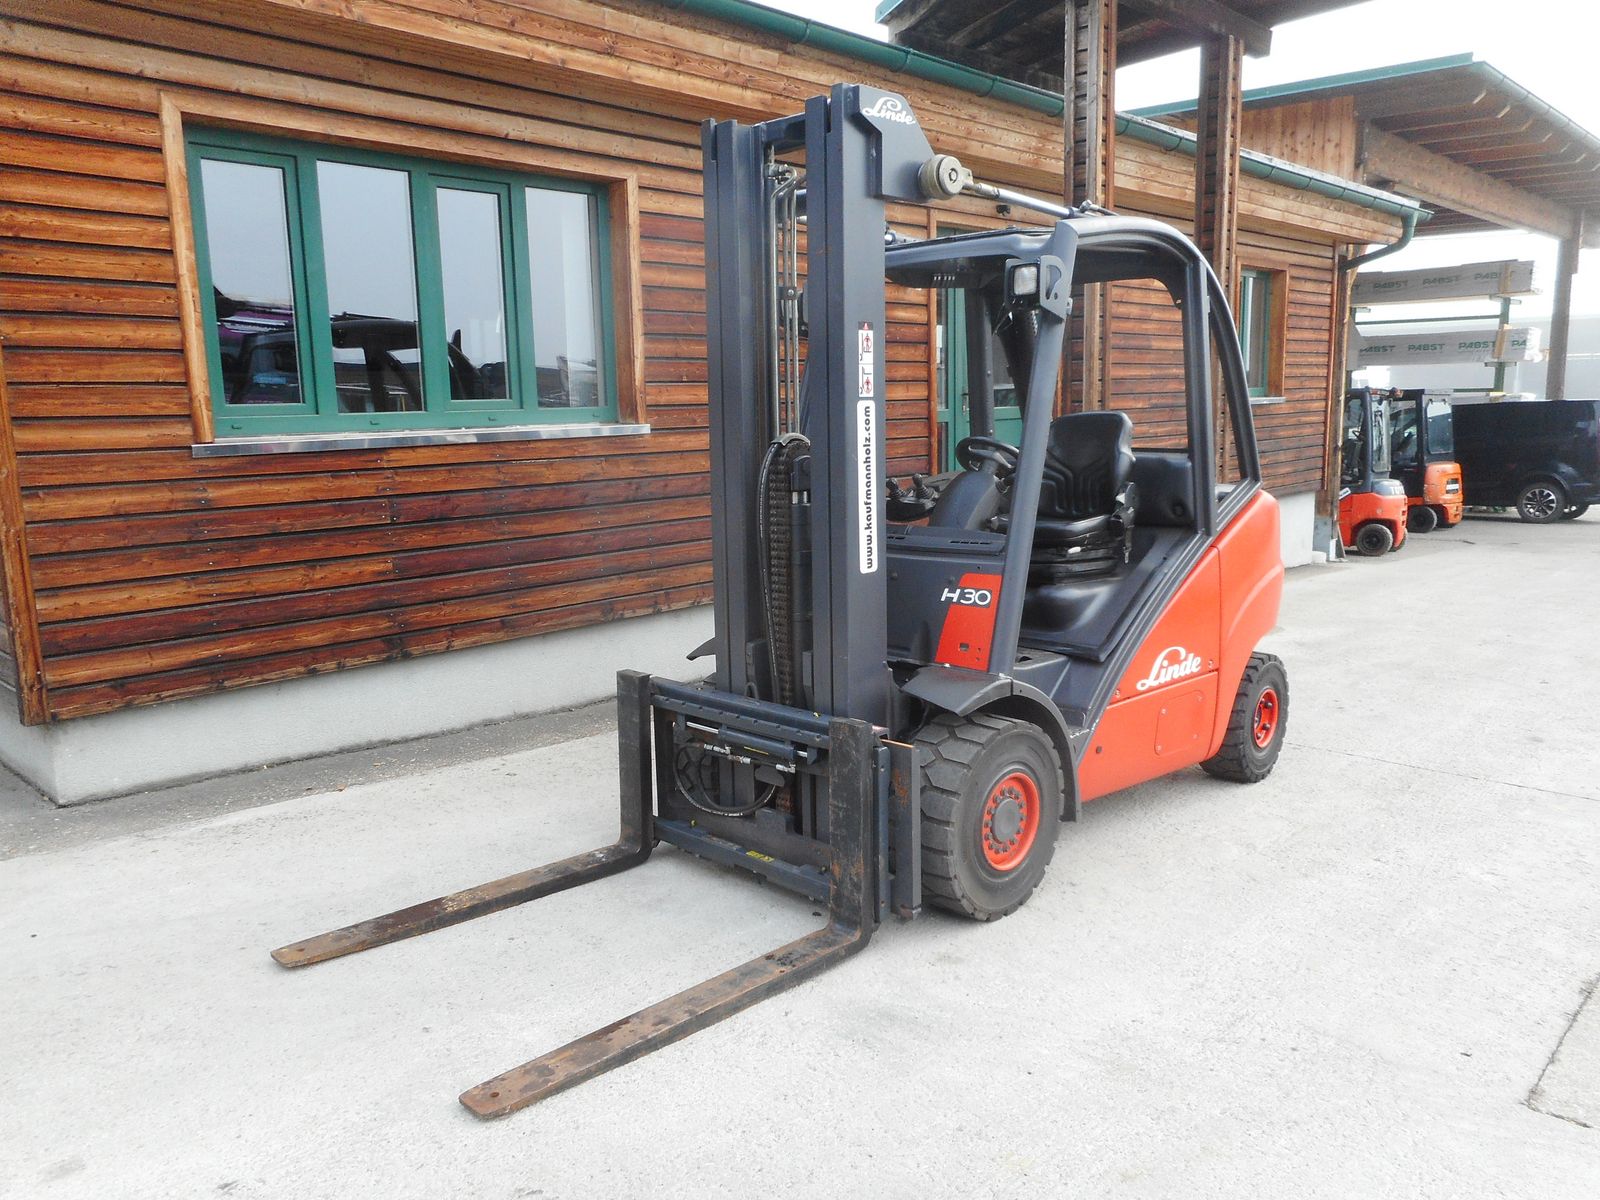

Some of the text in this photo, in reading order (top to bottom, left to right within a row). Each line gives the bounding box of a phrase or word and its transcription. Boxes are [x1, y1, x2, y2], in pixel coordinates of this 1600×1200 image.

[862, 97, 916, 125] Linde
[1373, 280, 1408, 289] PABST
[1422, 275, 1461, 286] PABST
[1408, 343, 1445, 352] PABST
[863, 406, 873, 569] www.kaufmannholz.com
[1136, 646, 1201, 690] Linde
